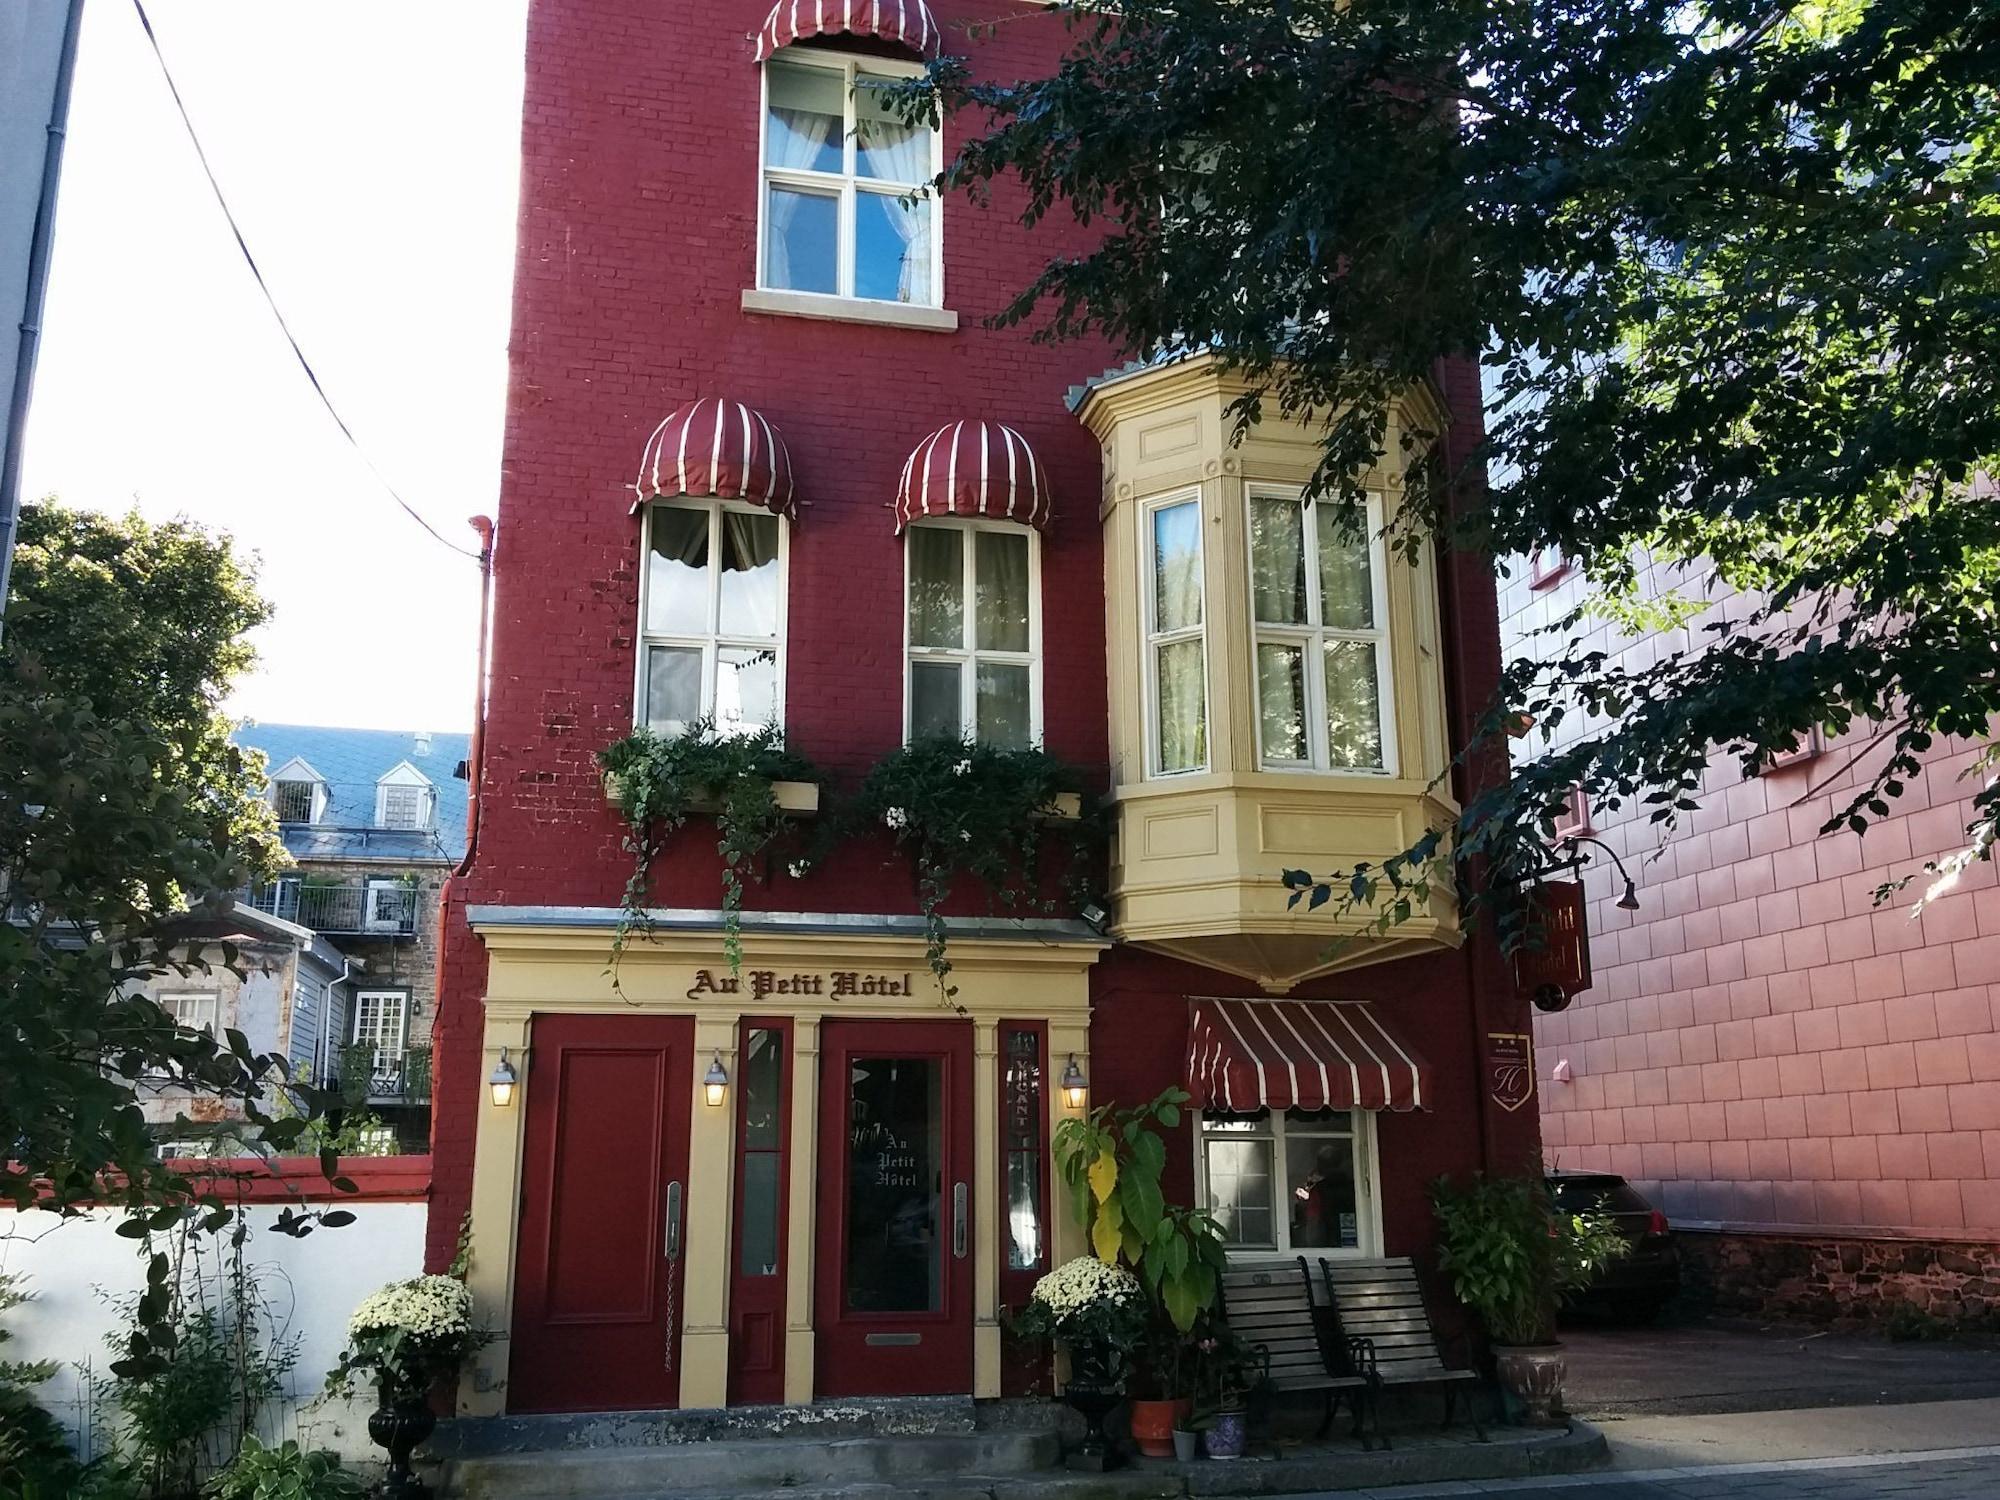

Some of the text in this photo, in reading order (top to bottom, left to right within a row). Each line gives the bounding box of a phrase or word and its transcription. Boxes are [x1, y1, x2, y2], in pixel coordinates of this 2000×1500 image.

[687, 969, 912, 1001] Au Petit Hôtel
[885, 1133, 907, 1149] Au
[877, 1152, 915, 1170] Petit
[875, 1171, 916, 1186] Hôtel
